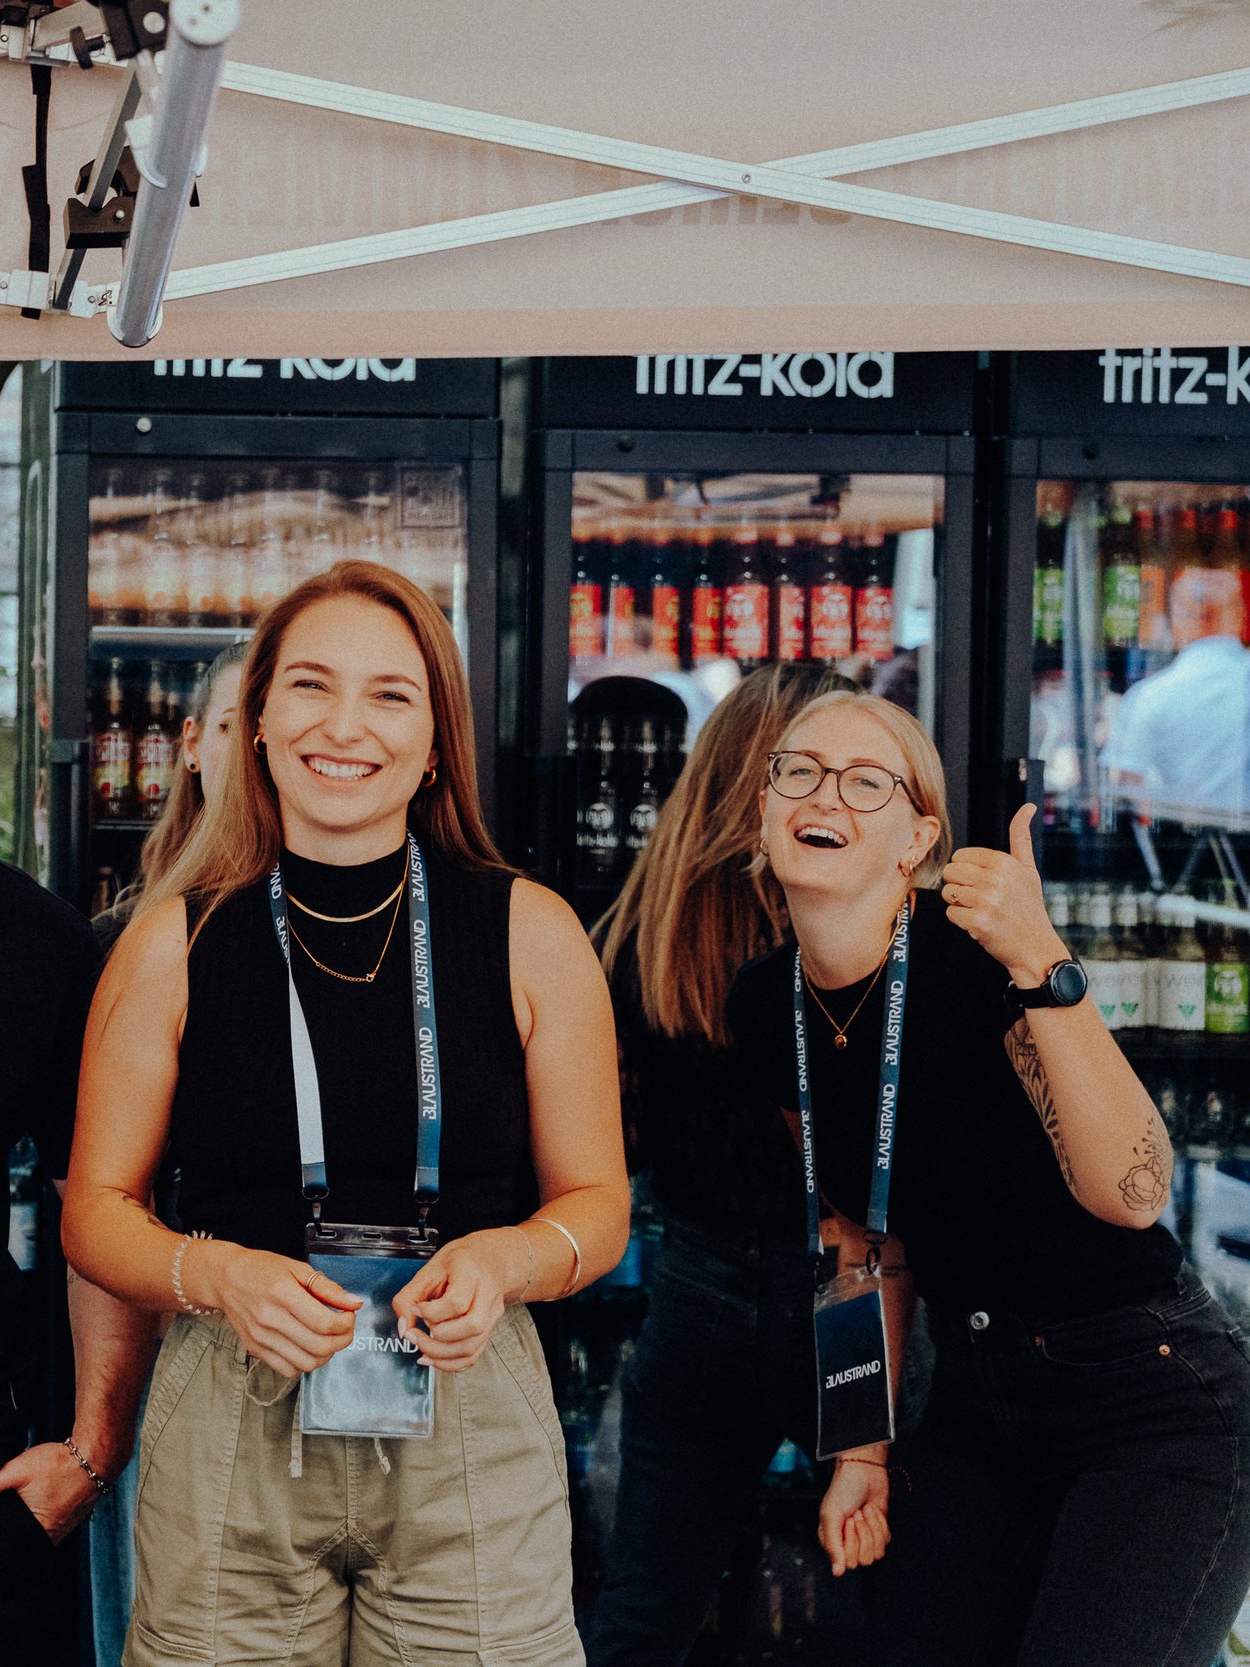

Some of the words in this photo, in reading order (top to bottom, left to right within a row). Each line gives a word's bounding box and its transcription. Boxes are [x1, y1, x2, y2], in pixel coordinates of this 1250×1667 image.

[413, 919, 431, 1009] BLAUSTRAND
[795, 1009, 808, 1092] BLAUSTRAND
[885, 980, 904, 1066] BLAUSTRAND
[418, 1026, 437, 1120] BLAUSTRAND
[801, 1109, 815, 1194] BLAUSTRAND
[877, 1083, 896, 1170] BLAUSTRAND
[349, 1337, 419, 1353] USTRAND
[826, 1360, 881, 1389] BLAUSTRAND
